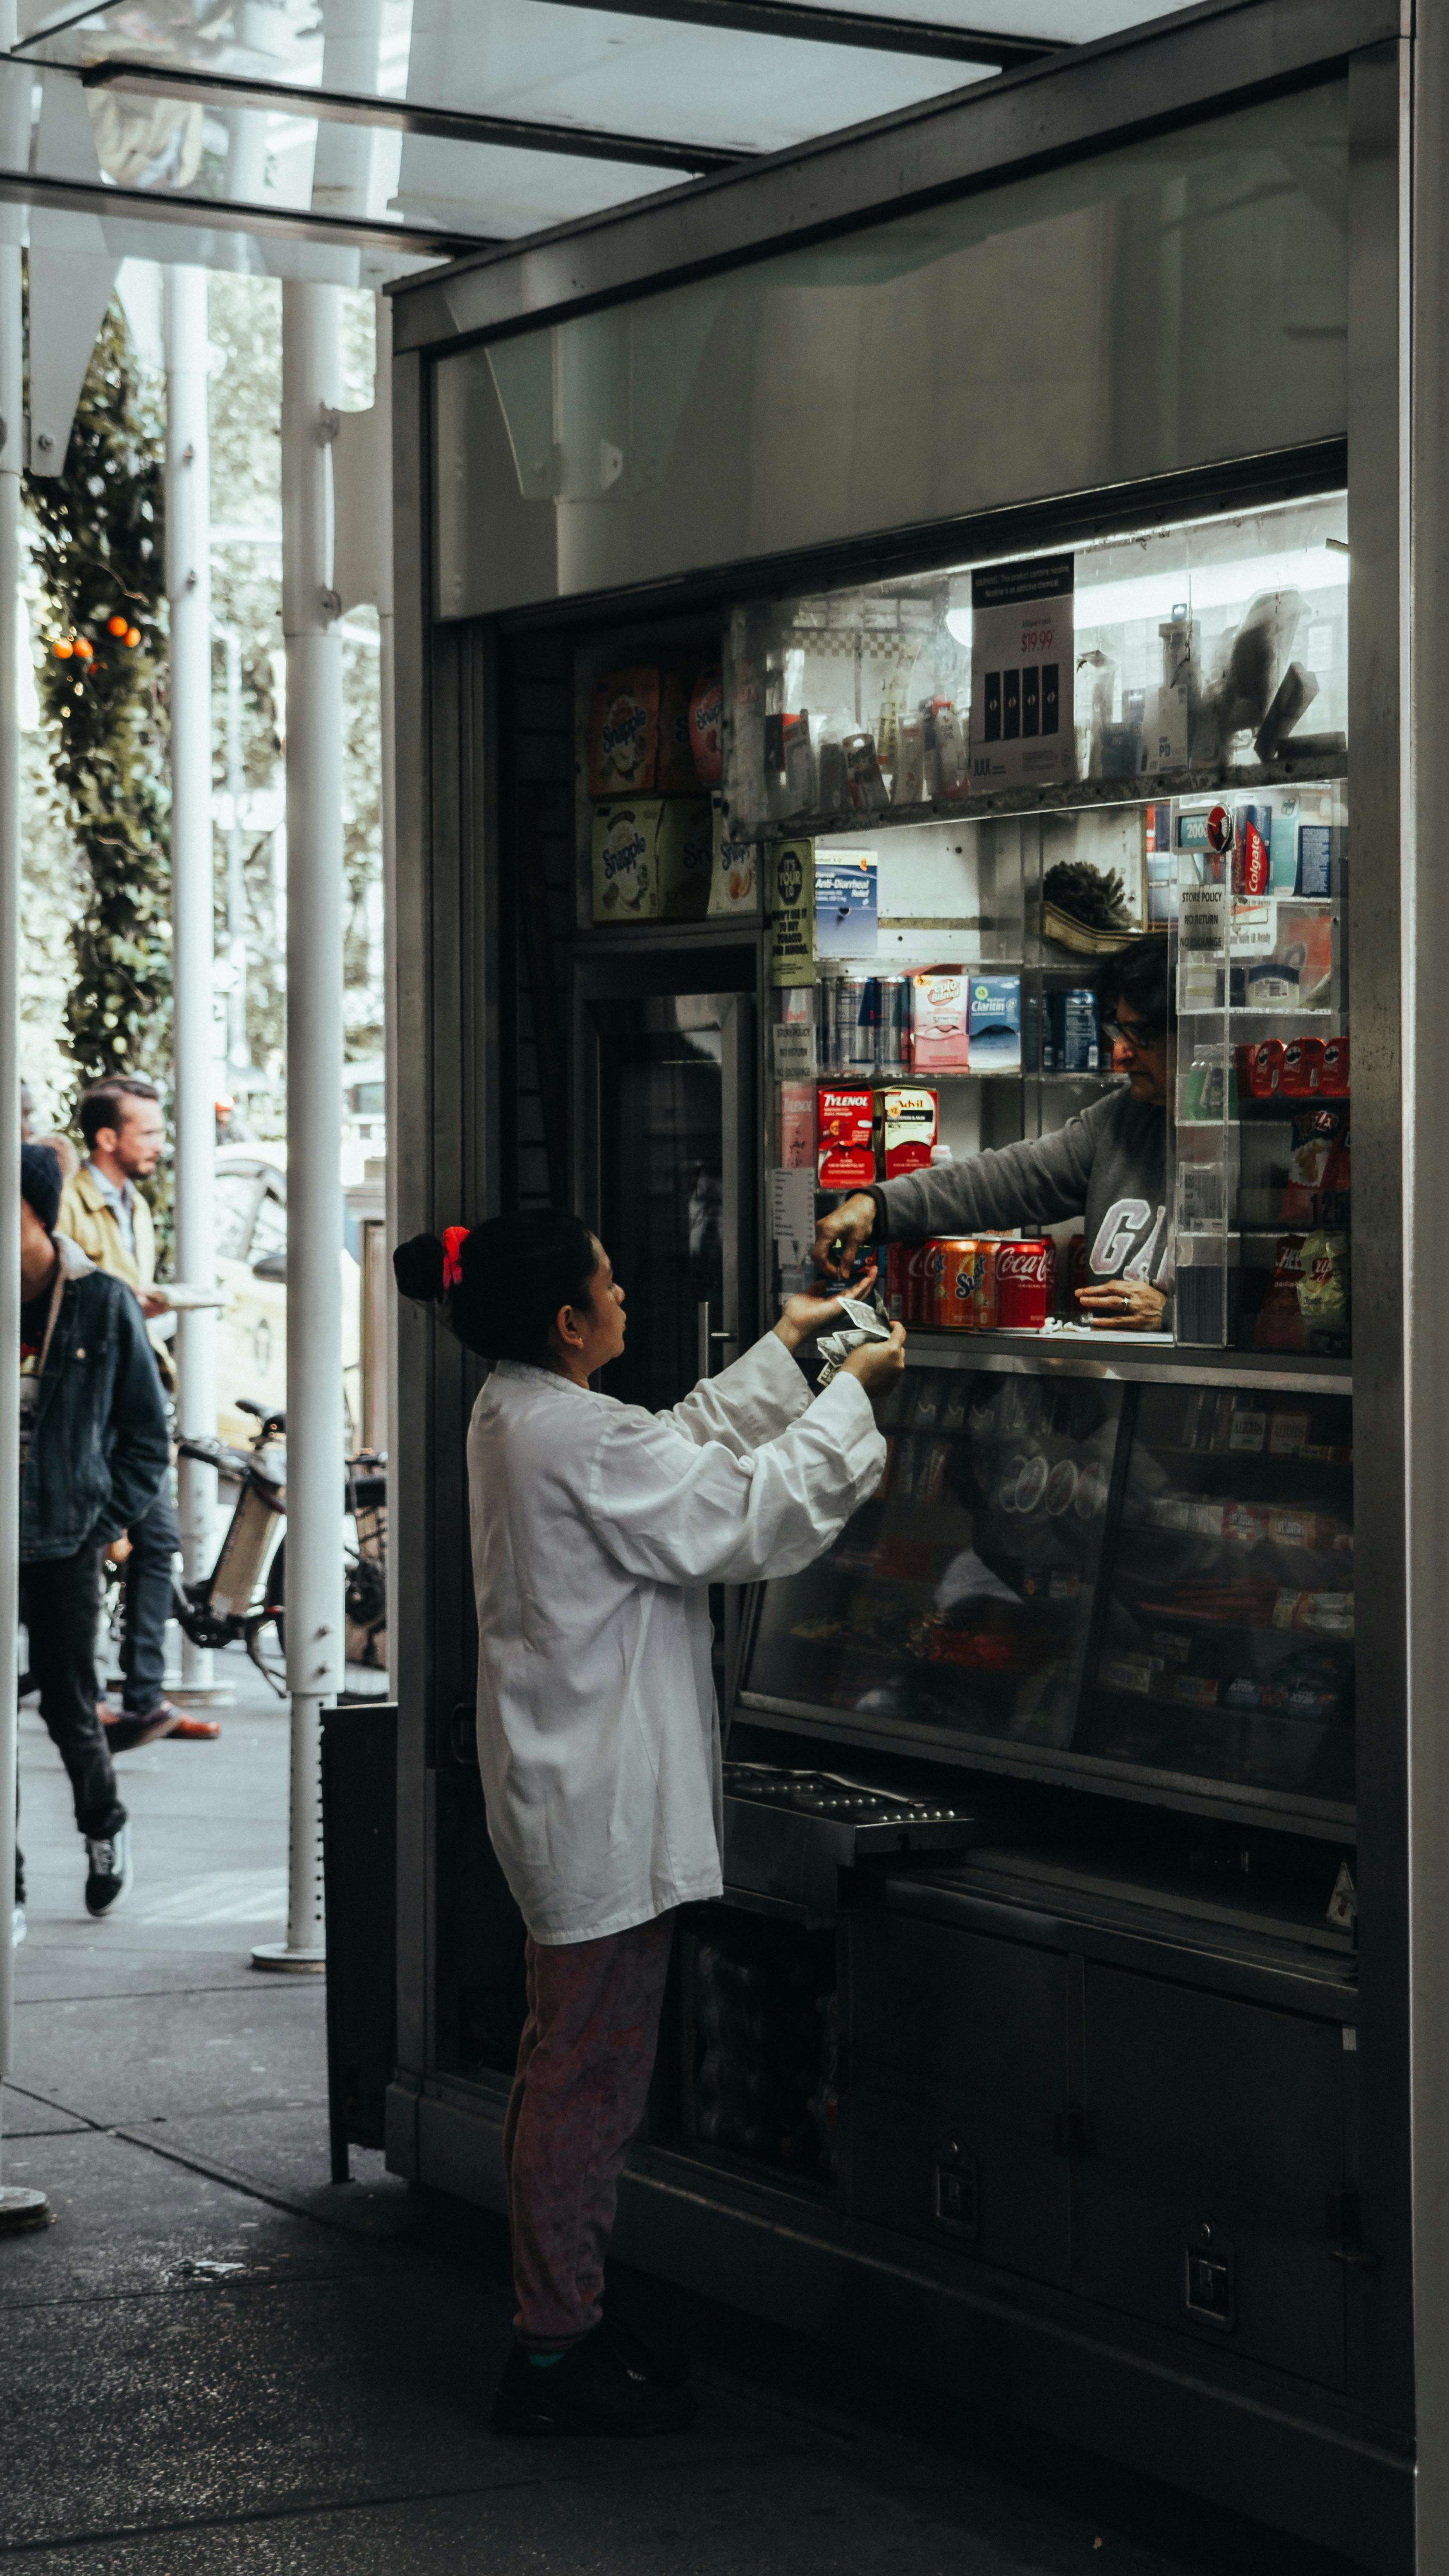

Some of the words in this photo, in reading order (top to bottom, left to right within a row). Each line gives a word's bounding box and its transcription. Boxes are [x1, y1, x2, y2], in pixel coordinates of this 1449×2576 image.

[1021, 630, 1053, 652] $19.99
[602, 706, 647, 753] Snapple
[602, 832, 647, 880] Snapple
[1249, 835, 1261, 892] Colgate
[1182, 892, 1200, 902] STORE
[1202, 892, 1222, 902] POLICY
[1185, 915, 1193, 925] NO
[1194, 914, 1219, 925] RETURN
[1180, 937, 1189, 947] NO
[1190, 936, 1222, 948] EXCHANGE
[971, 1000, 1005, 1012] Claritin
[824, 1094, 868, 1107] TYLENOL
